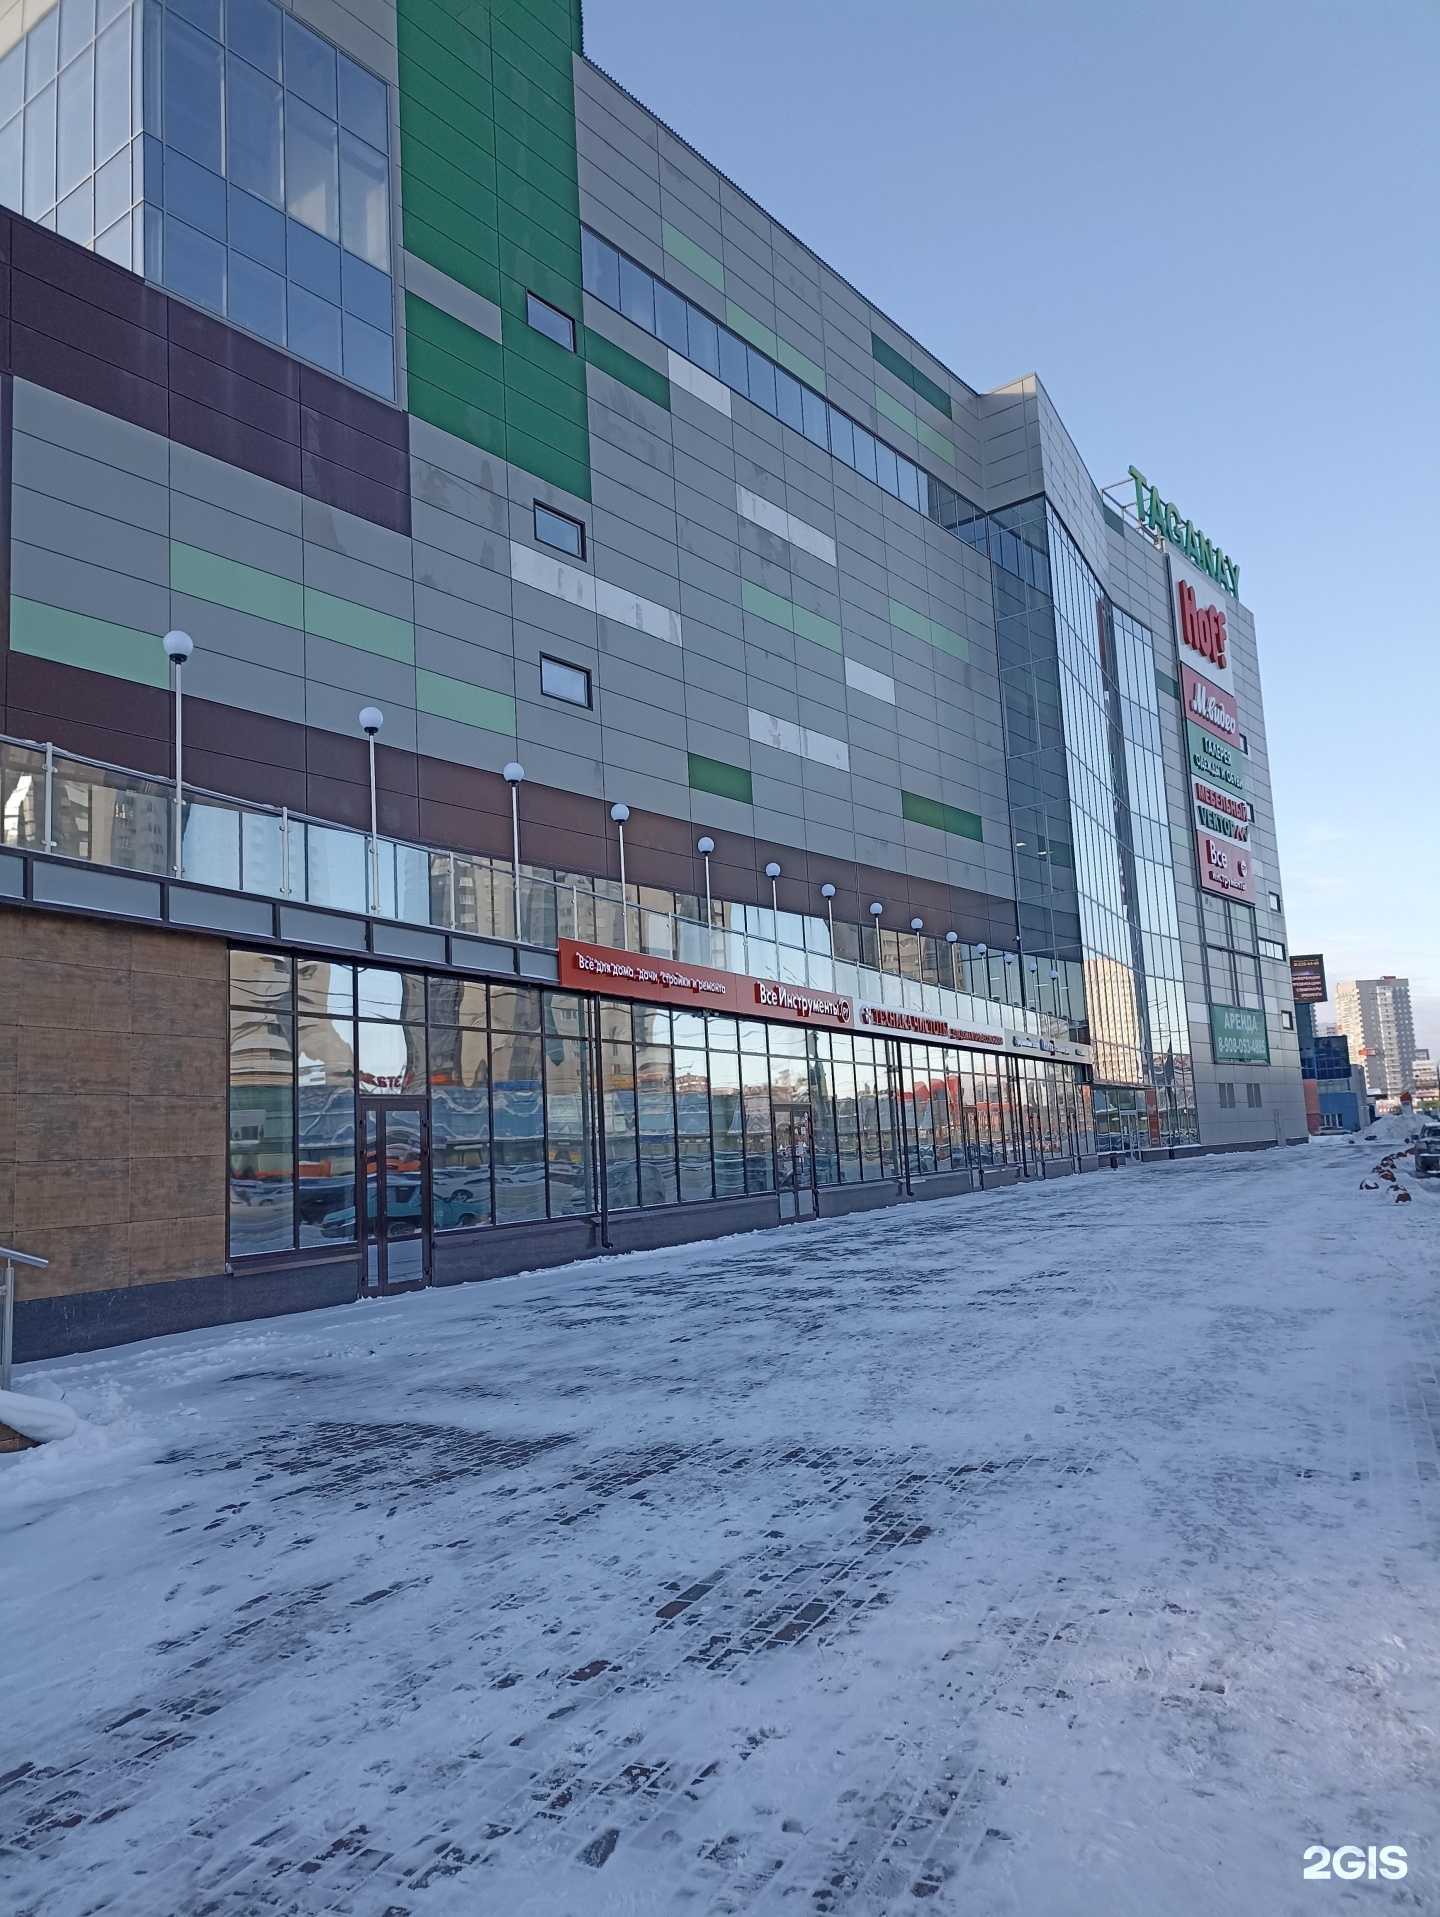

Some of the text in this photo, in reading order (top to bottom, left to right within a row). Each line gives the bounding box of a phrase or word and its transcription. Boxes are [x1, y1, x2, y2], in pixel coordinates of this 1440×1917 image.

[1128, 465, 1240, 600] TAGANAY
[1208, 839, 1227, 868] Все
[596, 961, 611, 975] для
[661, 972, 691, 989] стройки
[697, 979, 726, 994] ремонта
[1224, 1011, 1258, 1035] АРЕНДА
